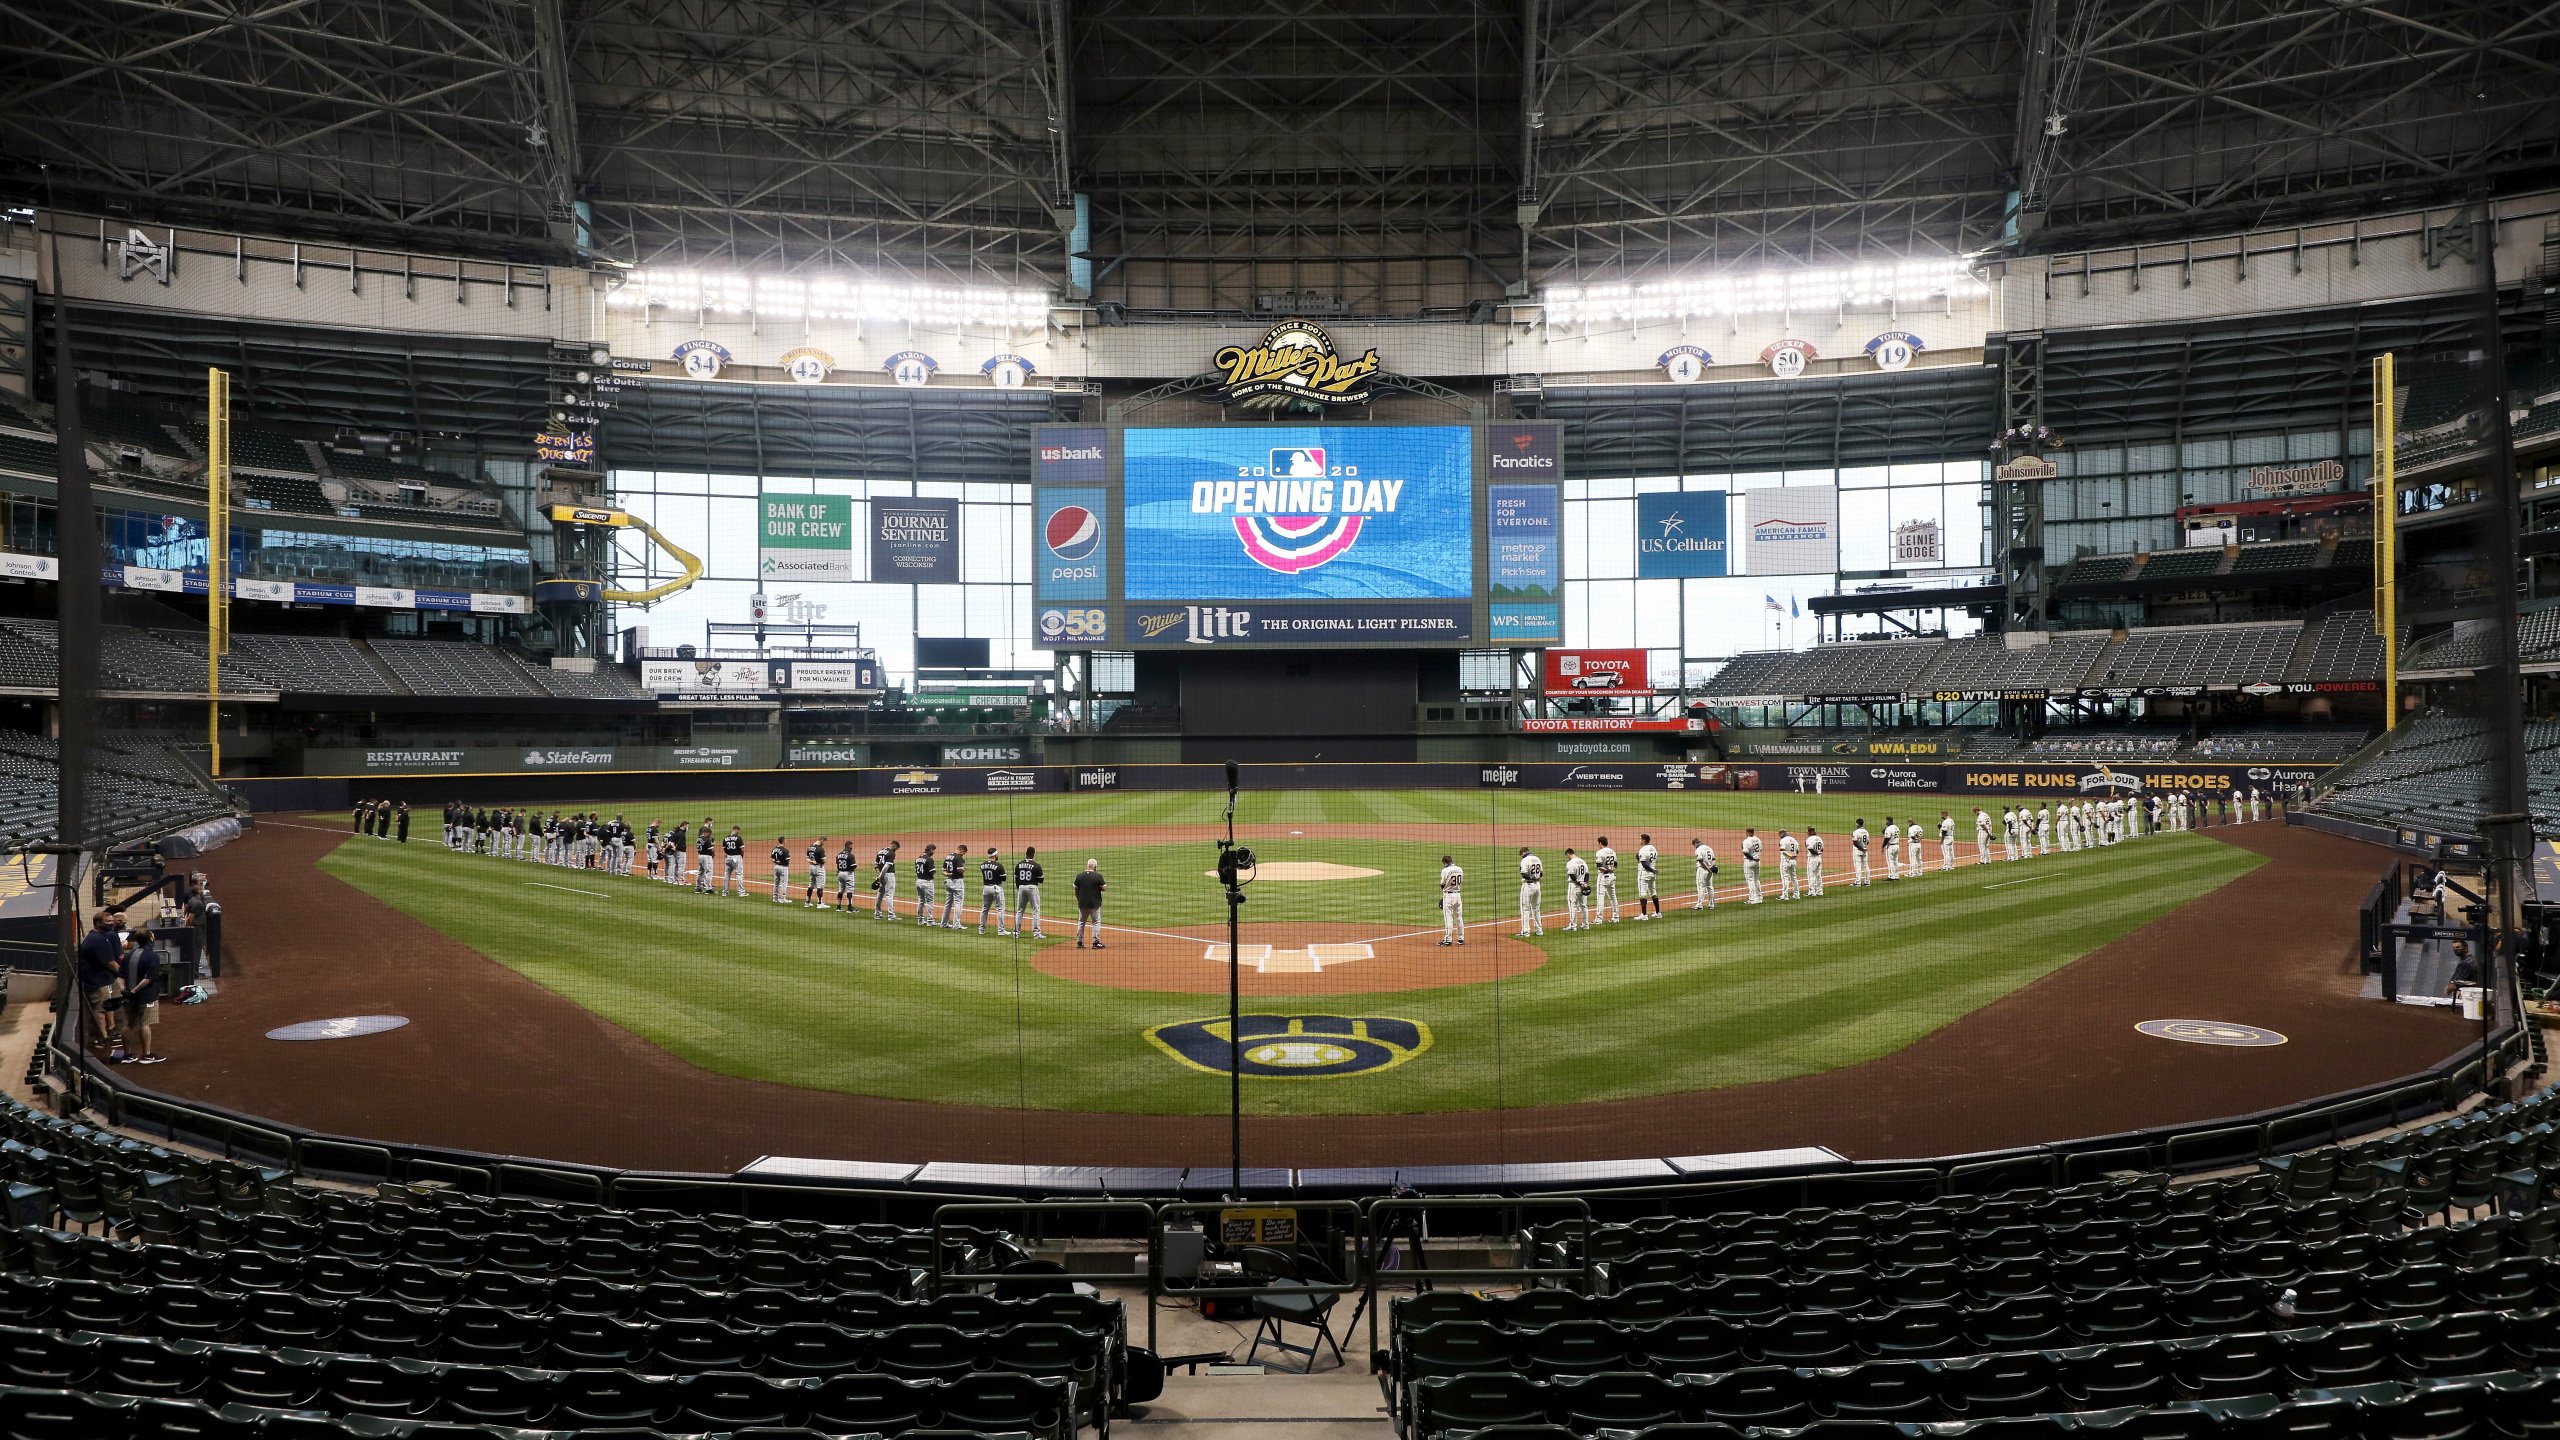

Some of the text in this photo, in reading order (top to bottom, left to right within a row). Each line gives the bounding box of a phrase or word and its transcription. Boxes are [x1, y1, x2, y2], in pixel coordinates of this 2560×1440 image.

[1271, 322, 1322, 337] SINCE 2001
[1877, 333, 1909, 343] YOUNT
[682, 341, 722, 353] FINGERS
[1770, 341, 1805, 351] UECKER
[896, 352, 925, 362] AARON
[995, 353, 1022, 363] SELIG
[1665, 347, 1704, 359] MOLITOR
[1884, 347, 1907, 365] 19
[612, 359, 651, 370] Gone!
[689, 354, 716, 373] 34
[1779, 352, 1798, 366] 50
[795, 361, 821, 379] 42
[1215, 343, 1379, 392] Miller Park
[1678, 361, 1689, 377] 4
[898, 365, 922, 383] 44
[1003, 369, 1012, 386] 1
[593, 376, 642, 388] Get Outta
[596, 384, 620, 393] Here
[1231, 386, 1253, 398] HOME
[1254, 383, 1265, 391] OF
[1284, 385, 1330, 401] MILWAUKEE
[1331, 391, 1369, 402] BREWERS
[597, 401, 610, 409] Up
[568, 415, 600, 425] Get Up
[534, 431, 593, 450] BERNIE'S
[1492, 454, 1553, 468] Fanatics
[1998, 464, 2055, 480] Johnsonville
[2248, 460, 2344, 487] Johnsonville
[2300, 481, 2327, 490] DECK
[1191, 480, 1404, 513] OPENING DAY
[1497, 499, 1526, 507] FRESH
[575, 511, 607, 521] SARGENTO
[767, 503, 827, 520] BANK OF
[1497, 509, 1516, 517] FOR
[881, 516, 949, 529] JOURNAL
[1497, 518, 1552, 526] EVERYONE.
[767, 520, 797, 537] OUR
[1755, 526, 1826, 535] AMERICAN FAMILY
[881, 528, 949, 541] SENTINEL
[1900, 534, 1935, 546] LEINIE
[890, 541, 940, 549] jsonline.com
[1502, 544, 1535, 553] metro
[1641, 537, 1725, 552] U.S. Cellular
[1502, 553, 1540, 562] market
[1900, 546, 1935, 559] LODGE
[5, 562, 32, 570] Johnson
[10, 569, 37, 577] Controls
[1052, 565, 1097, 582] pepsi
[752, 599, 767, 609] Lite
[787, 600, 828, 624] Lite
[1065, 609, 1106, 636] 58
[1137, 606, 1458, 644] Miller Lite THE ORIGINAL LIGHT PILSNER.
[1493, 616, 1520, 626] WPS
[1584, 660, 1630, 670] TOYOTA
[975, 696, 1023, 704] CHECK DECK
[1936, 690, 2001, 701] 620 WTMJ
[1525, 719, 1634, 730] TOYOTA TERRITORY
[944, 748, 1021, 760] KOHL'S
[1557, 742, 1631, 755] buyatoyota.com
[1869, 743, 1937, 754] UWM.EDU
[680, 756, 713, 764] STREAMING
[802, 747, 856, 764] impact
[1482, 765, 1518, 787] meijer
[1787, 767, 1850, 777] TOWN BANK
[1887, 770, 1917, 779] Aurora
[2272, 769, 2316, 780] Aurora
[1080, 768, 1116, 788] meijer
[1887, 778, 1937, 788] Health Care
[1966, 773, 2231, 789] HOME RUNS FOR OUR HEROES
[727, 841, 737, 850] 30
[1605, 856, 1615, 866] 22
[983, 870, 993, 881] 10
[1019, 871, 1033, 881] 88
[1450, 875, 1462, 886] 30
